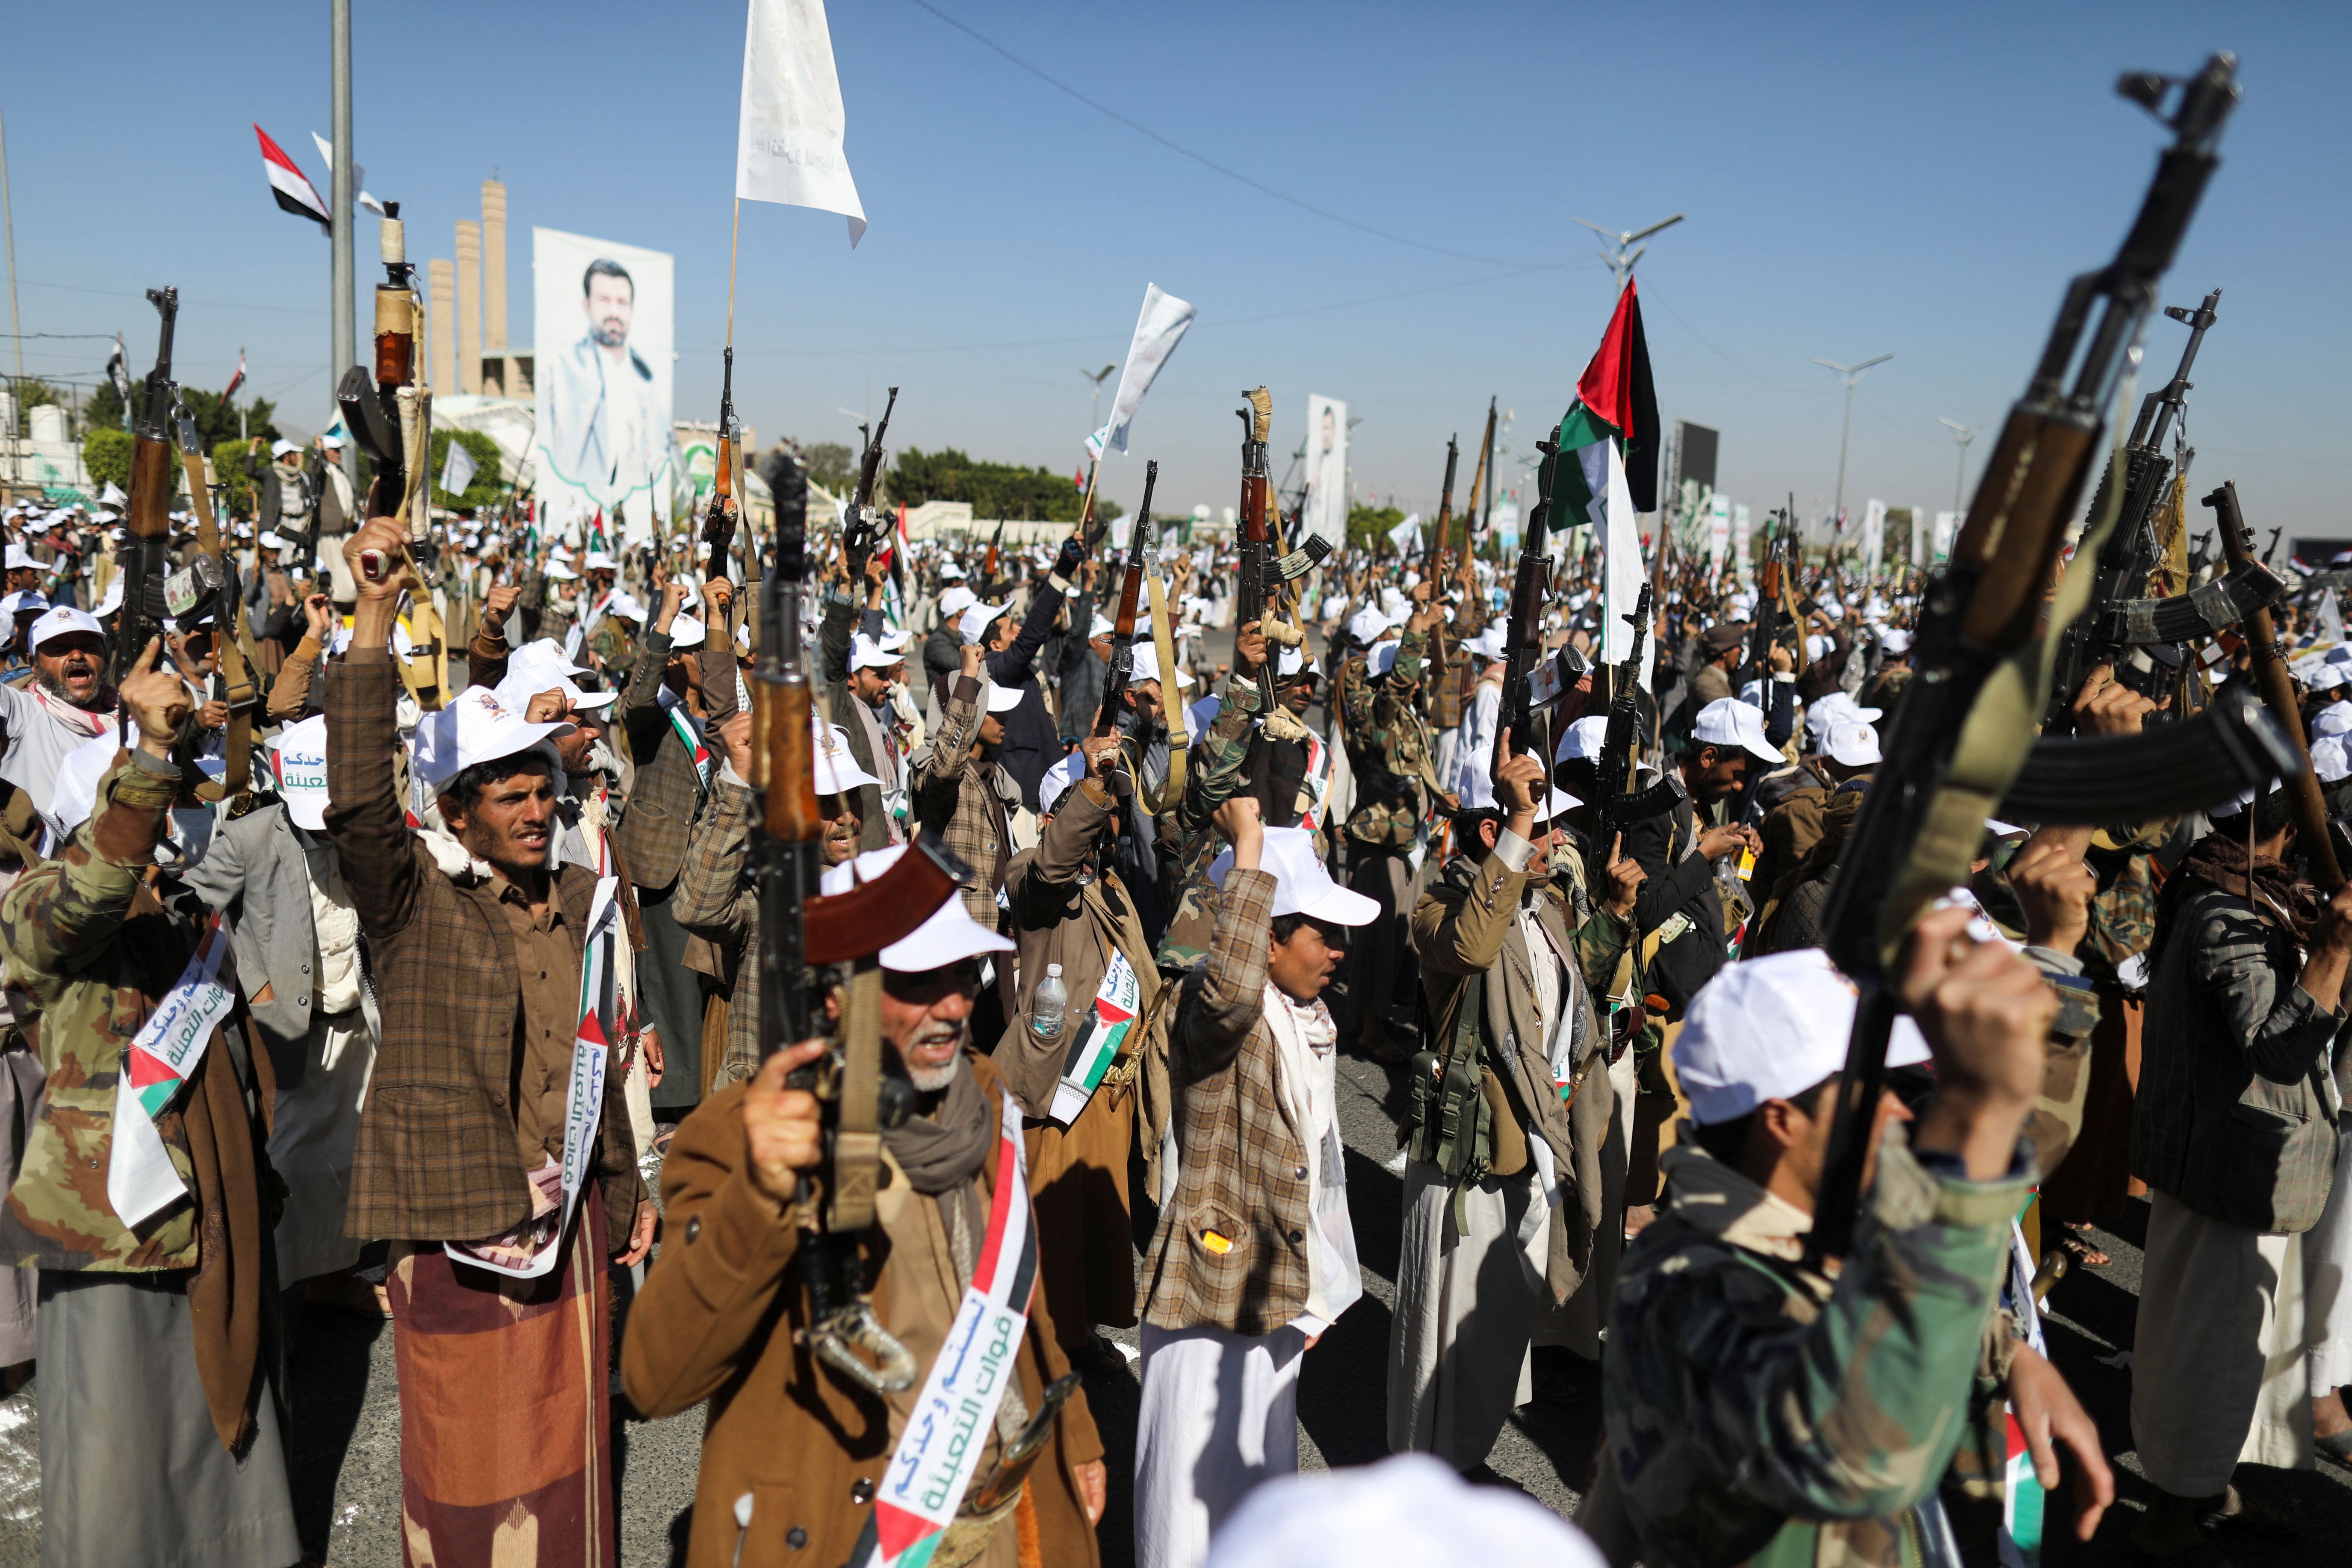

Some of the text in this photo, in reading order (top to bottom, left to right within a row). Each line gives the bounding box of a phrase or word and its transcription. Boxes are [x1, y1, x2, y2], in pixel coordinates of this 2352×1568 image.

[1106, 963, 1122, 1001] وحدكم
[166, 1009, 204, 1066] التعبئة
[586, 1048, 602, 1117] وحدكم
[565, 1044, 587, 1184] قوات التعبئة
[895, 1297, 985, 1501] لستم وحدكم
[920, 1315, 1012, 1512] قوات التعبئة
